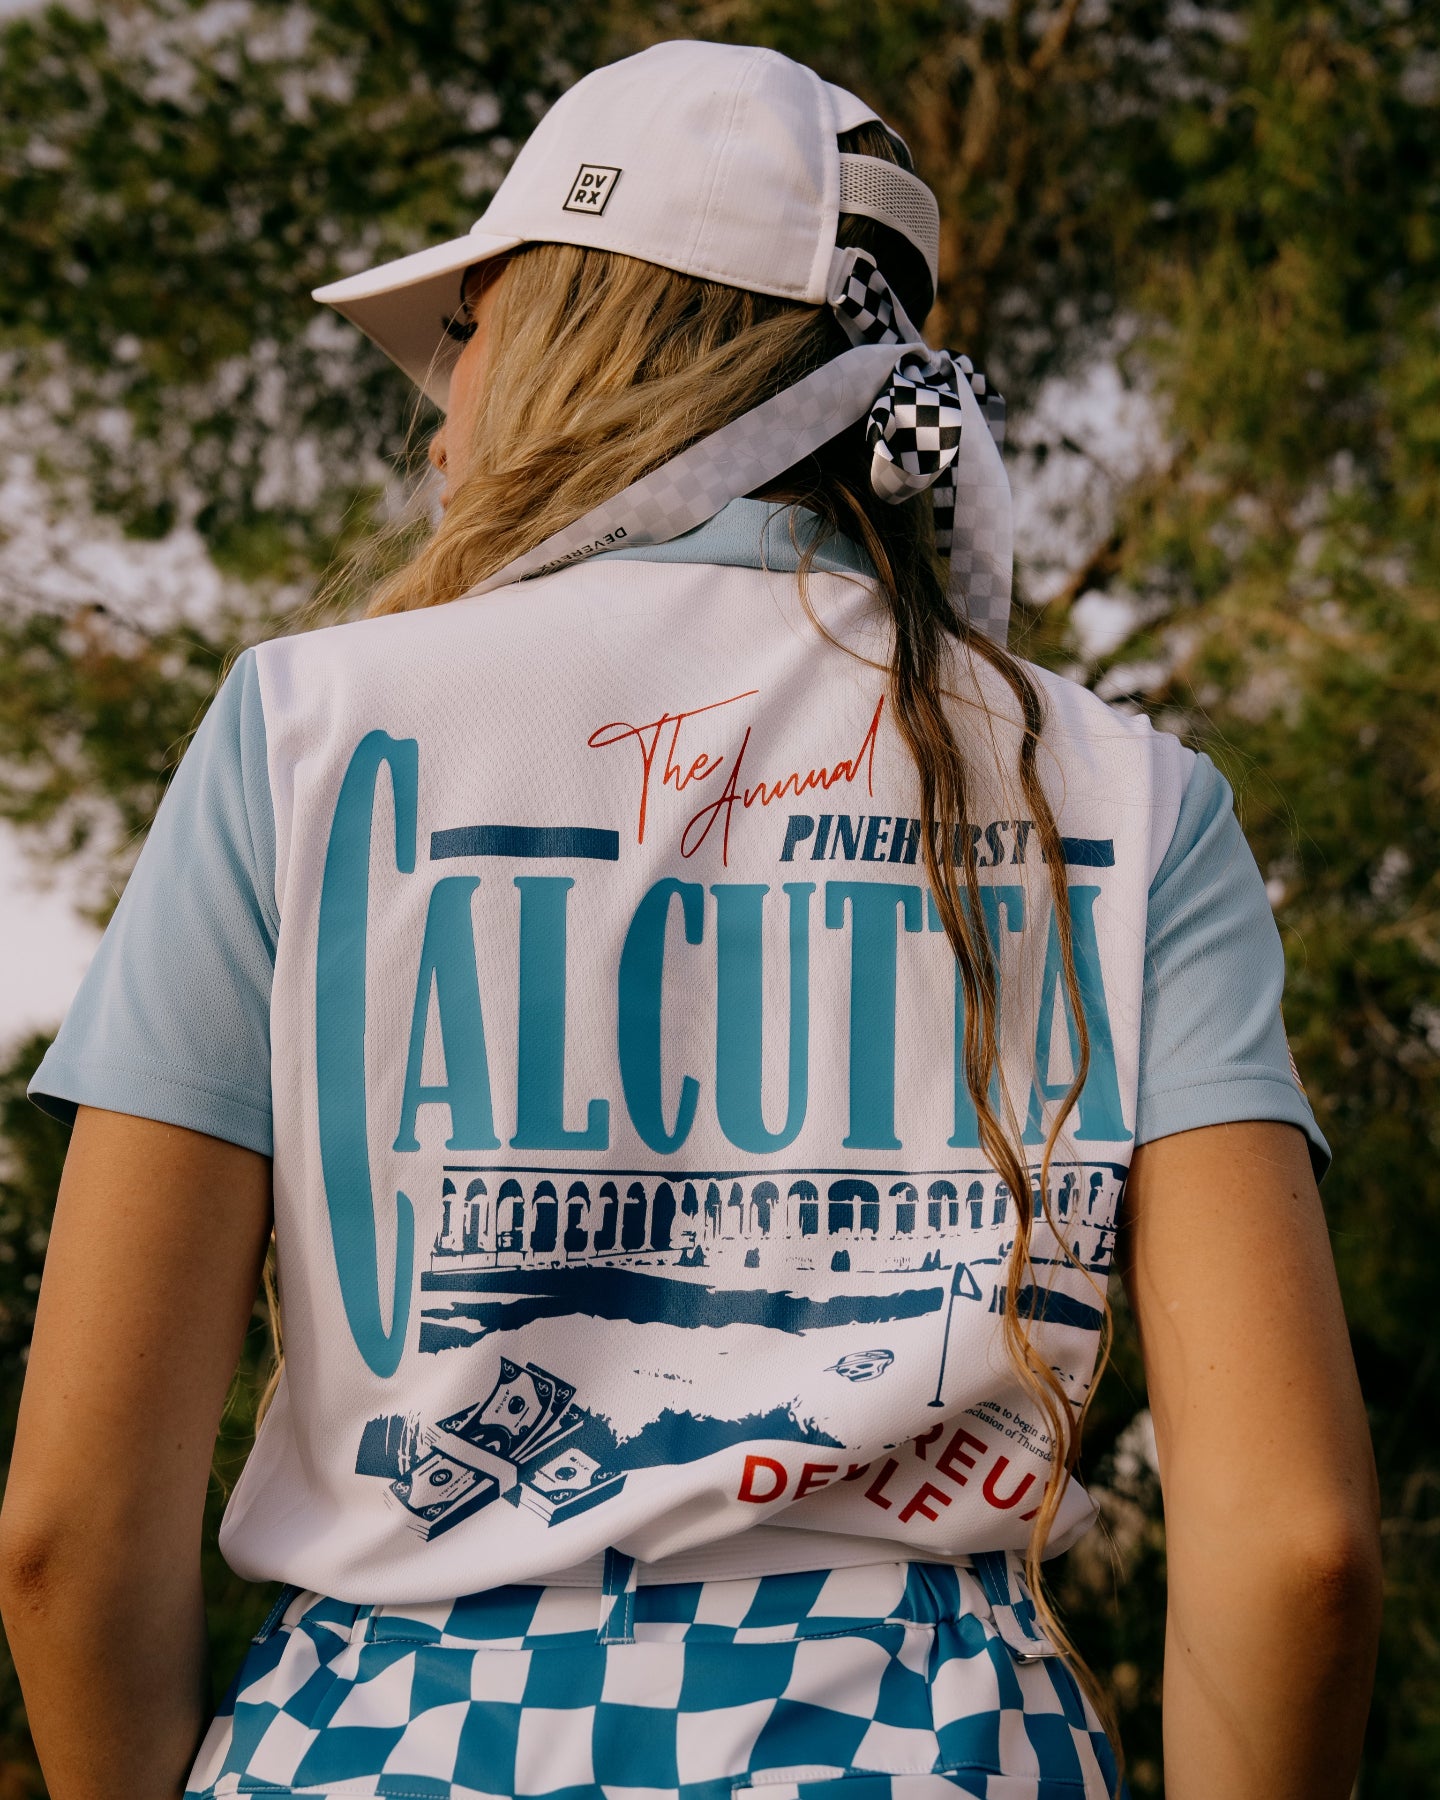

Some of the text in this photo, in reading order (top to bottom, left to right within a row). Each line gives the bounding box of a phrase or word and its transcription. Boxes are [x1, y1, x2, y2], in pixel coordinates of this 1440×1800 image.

[581, 173, 608, 188] DV
[574, 189, 601, 204] RX
[588, 690, 886, 867] The Annual
[316, 728, 1133, 1378] CALCUTTA
[1002, 1408, 1013, 1419] to
[1013, 1413, 1038, 1437] begin
[1005, 1428, 1019, 1439] of
